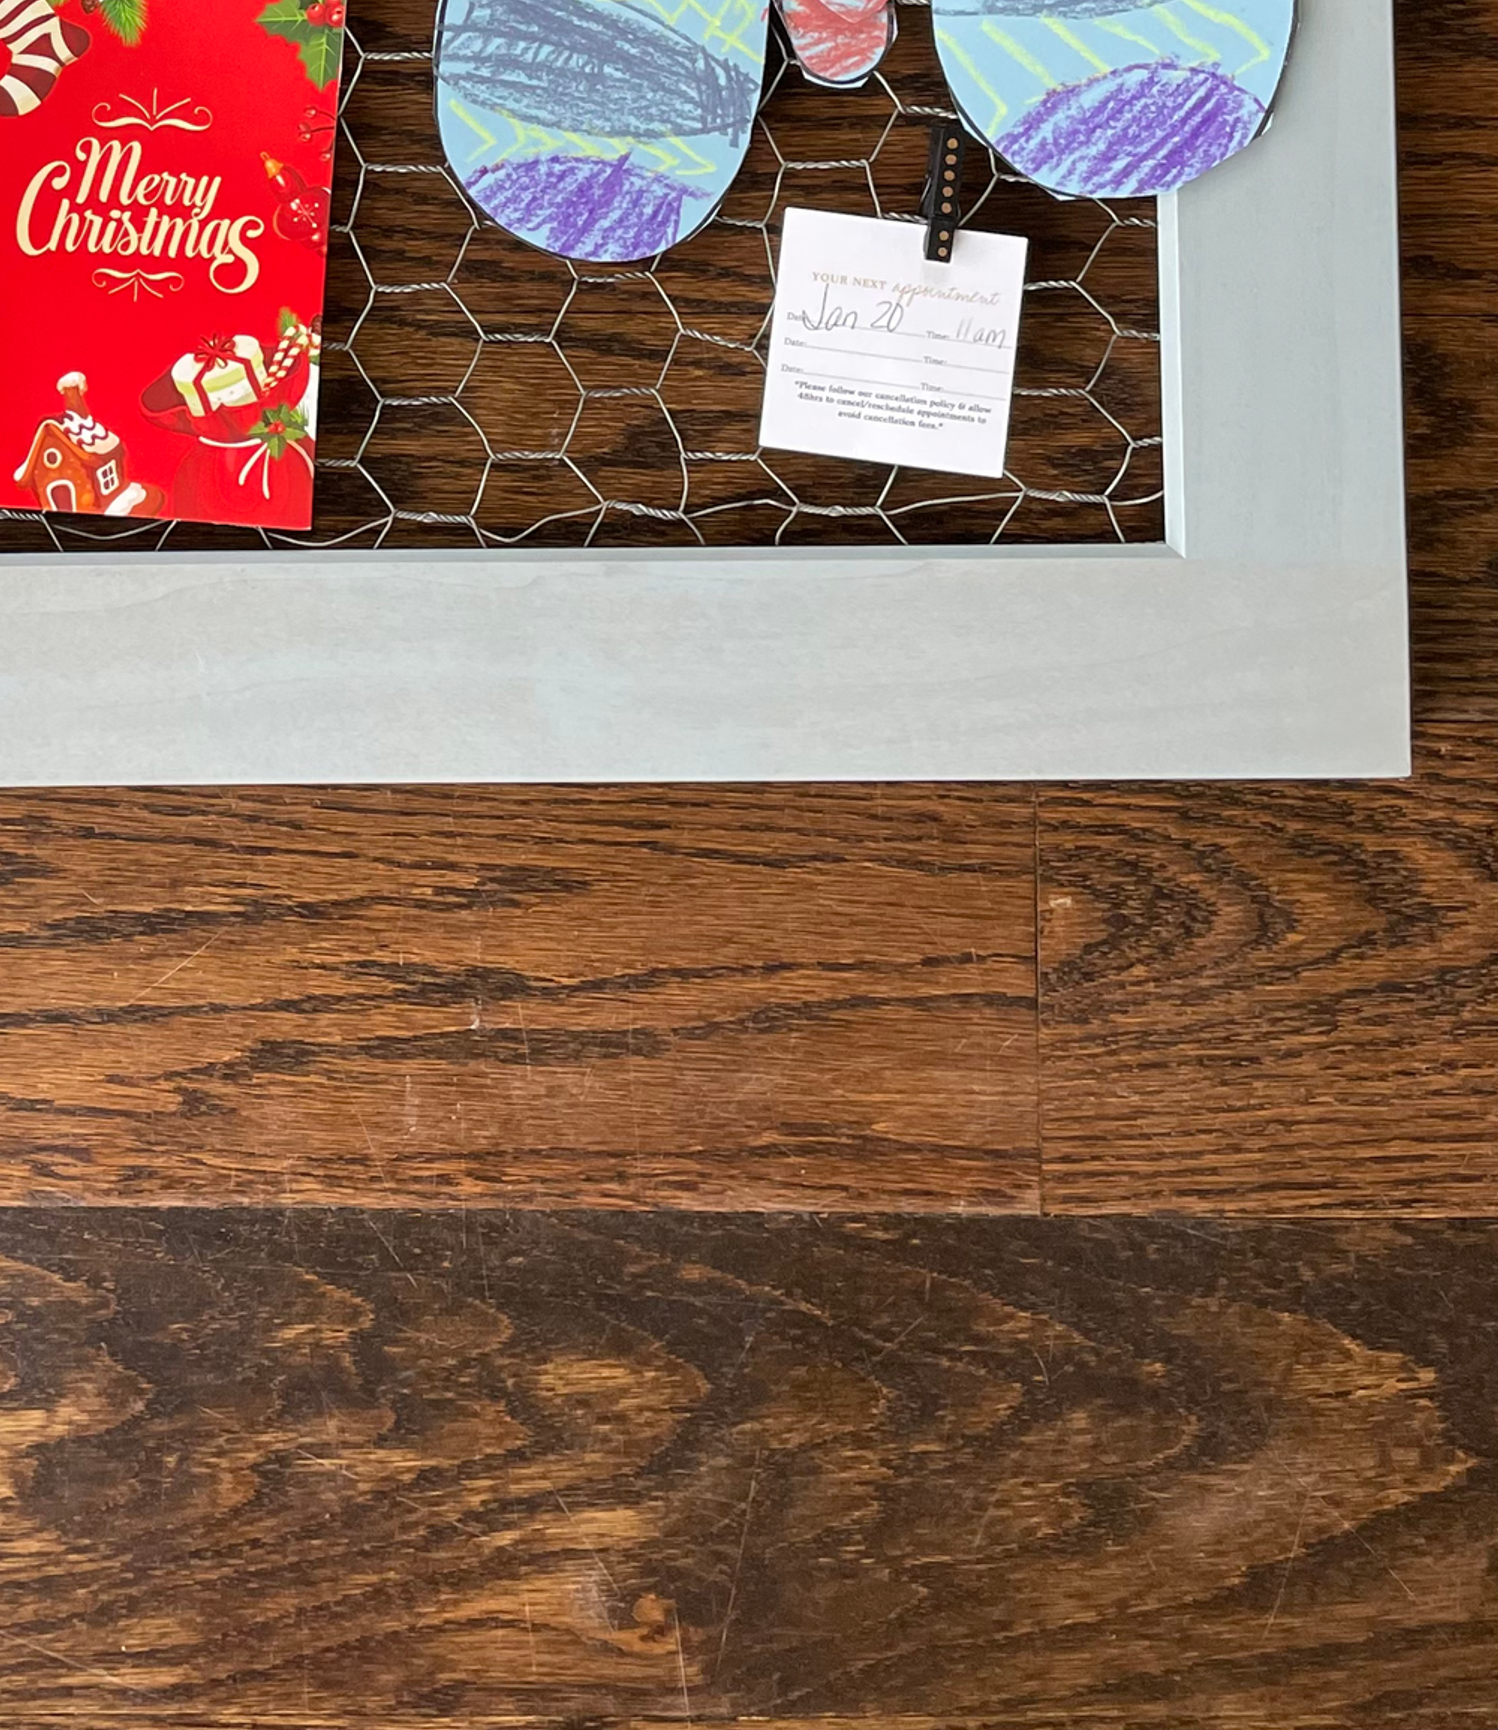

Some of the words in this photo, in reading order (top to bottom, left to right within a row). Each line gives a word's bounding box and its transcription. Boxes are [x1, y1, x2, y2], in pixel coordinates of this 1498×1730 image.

[75, 137, 222, 220] Merry
[16, 160, 265, 294] Christmas
[801, 282, 858, 331] Jan
[870, 300, 904, 333] 20
[812, 271, 848, 286] YOUR
[852, 277, 887, 290] NEXT
